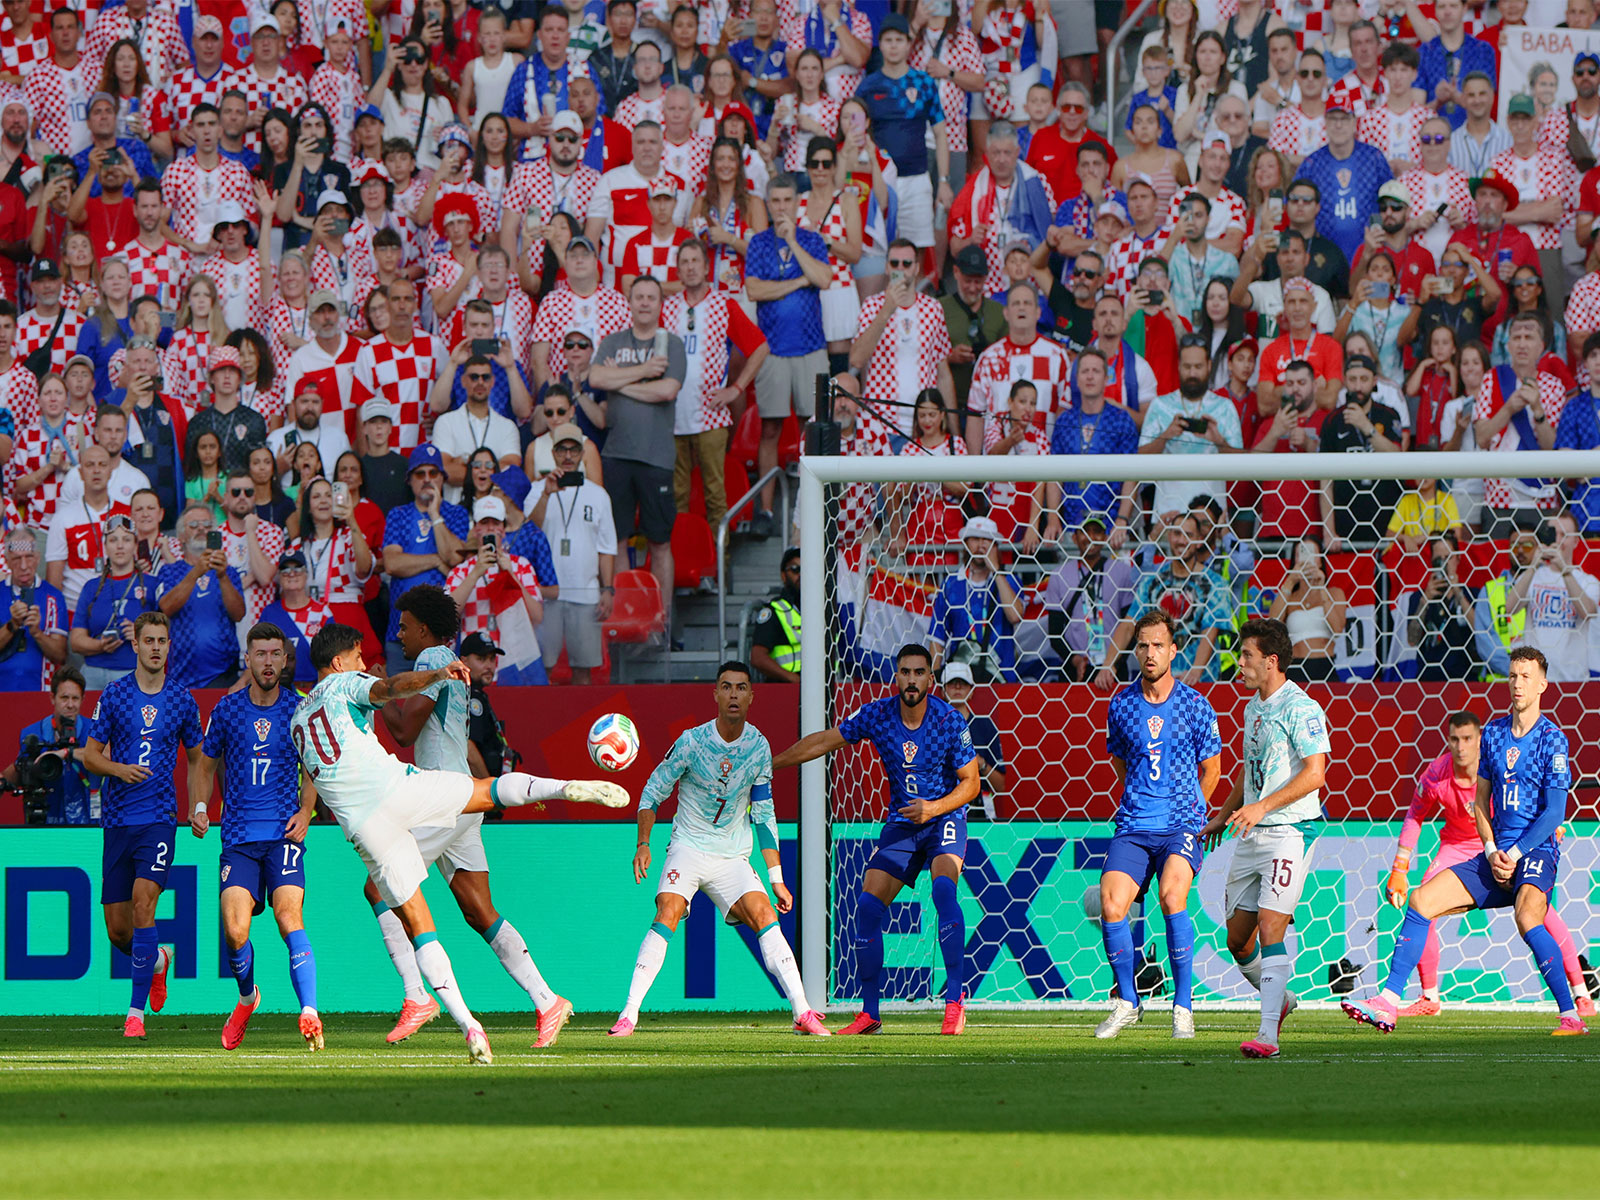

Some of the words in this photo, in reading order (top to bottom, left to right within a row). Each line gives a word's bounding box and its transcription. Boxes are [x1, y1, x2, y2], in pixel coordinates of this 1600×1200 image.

[1521, 31, 1576, 55] BABA
[70, 102, 90, 122] 10
[1334, 198, 1357, 220] 44
[138, 741, 151, 766] 2
[291, 705, 342, 780] 20
[251, 758, 272, 785] 17
[1149, 755, 1161, 781] 3
[905, 774, 918, 794] 6
[1502, 784, 1520, 811] 14
[713, 797, 727, 824] 7
[943, 821, 956, 840] 6
[1183, 832, 1195, 852] 3
[156, 842, 168, 866] 2
[283, 844, 301, 867] 17
[1523, 857, 1544, 874] 14
[1272, 858, 1293, 887] 15
